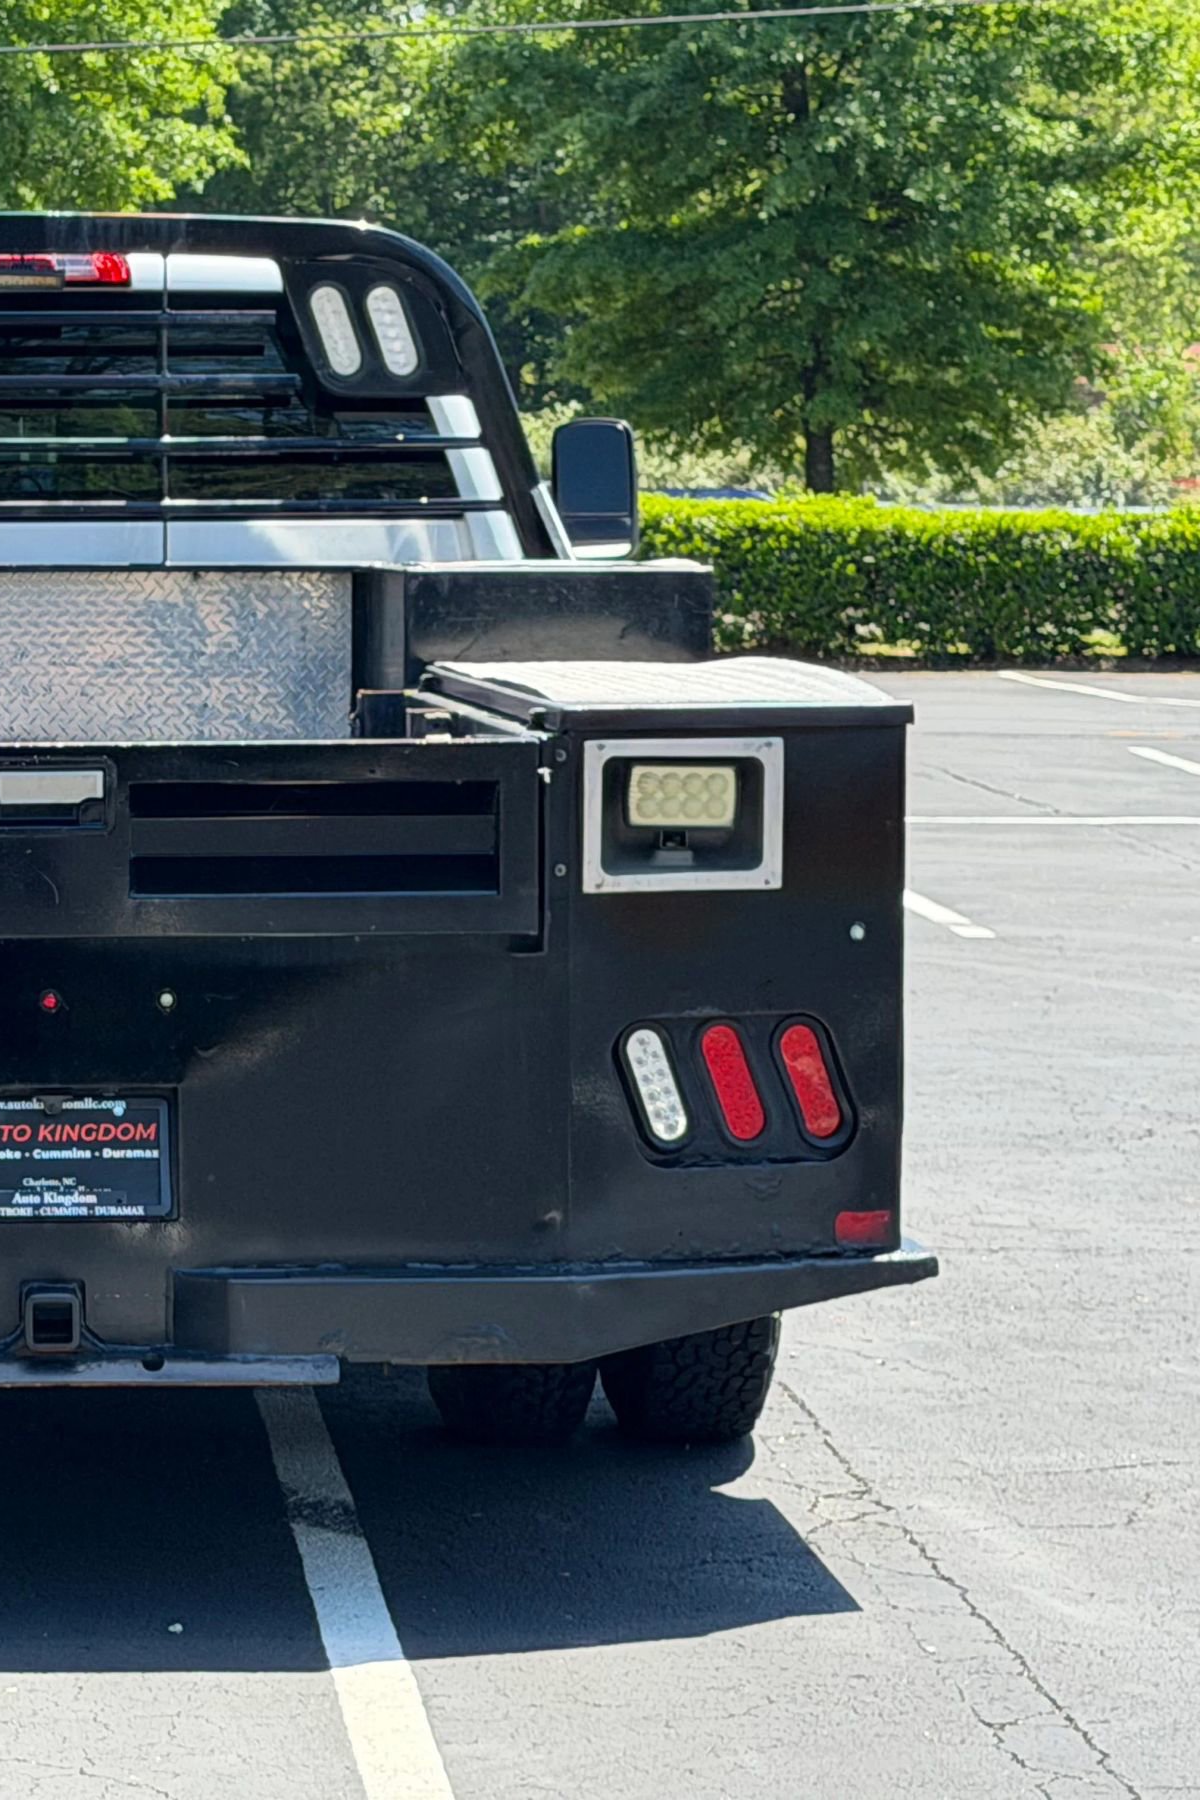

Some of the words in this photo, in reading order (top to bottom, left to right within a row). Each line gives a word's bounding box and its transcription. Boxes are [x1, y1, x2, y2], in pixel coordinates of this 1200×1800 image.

[38, 1122, 157, 1142] KINGDOM
[32, 1148, 91, 1159] Cummins
[102, 1148, 160, 1158] Duramax
[62, 1177, 77, 1186] NC
[12, 1192, 41, 1204] Auto
[43, 1191, 98, 1206] Kingdom
[39, 1206, 89, 1216] CUMMINS
[94, 1206, 145, 1216] DURAMAX
